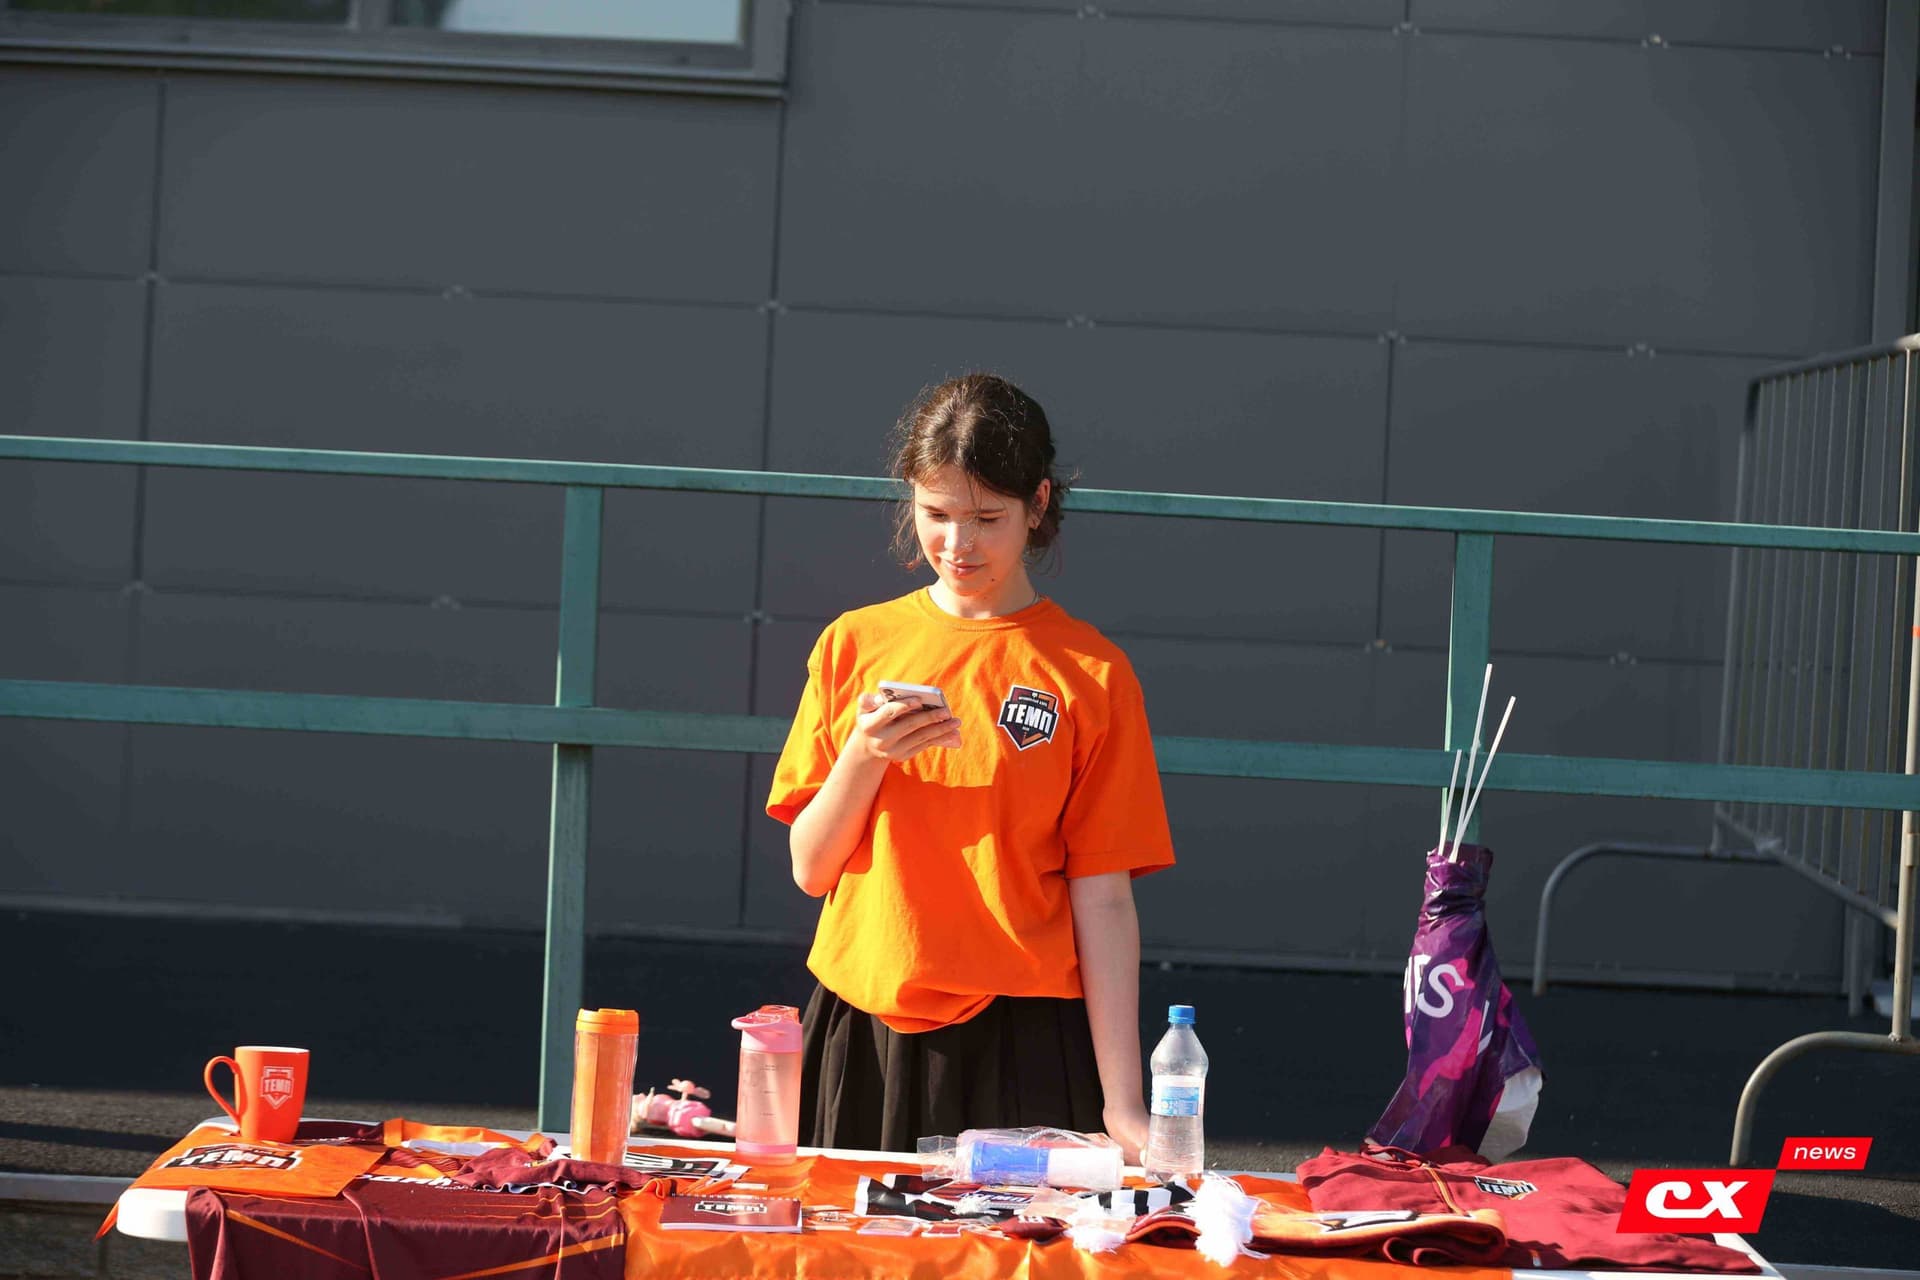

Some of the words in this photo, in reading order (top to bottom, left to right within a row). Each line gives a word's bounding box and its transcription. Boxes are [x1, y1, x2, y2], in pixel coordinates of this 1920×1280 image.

[1006, 703, 1053, 734] ТЕМП
[264, 1079, 291, 1093] ТЕМП
[180, 1149, 289, 1167] ТЕМП
